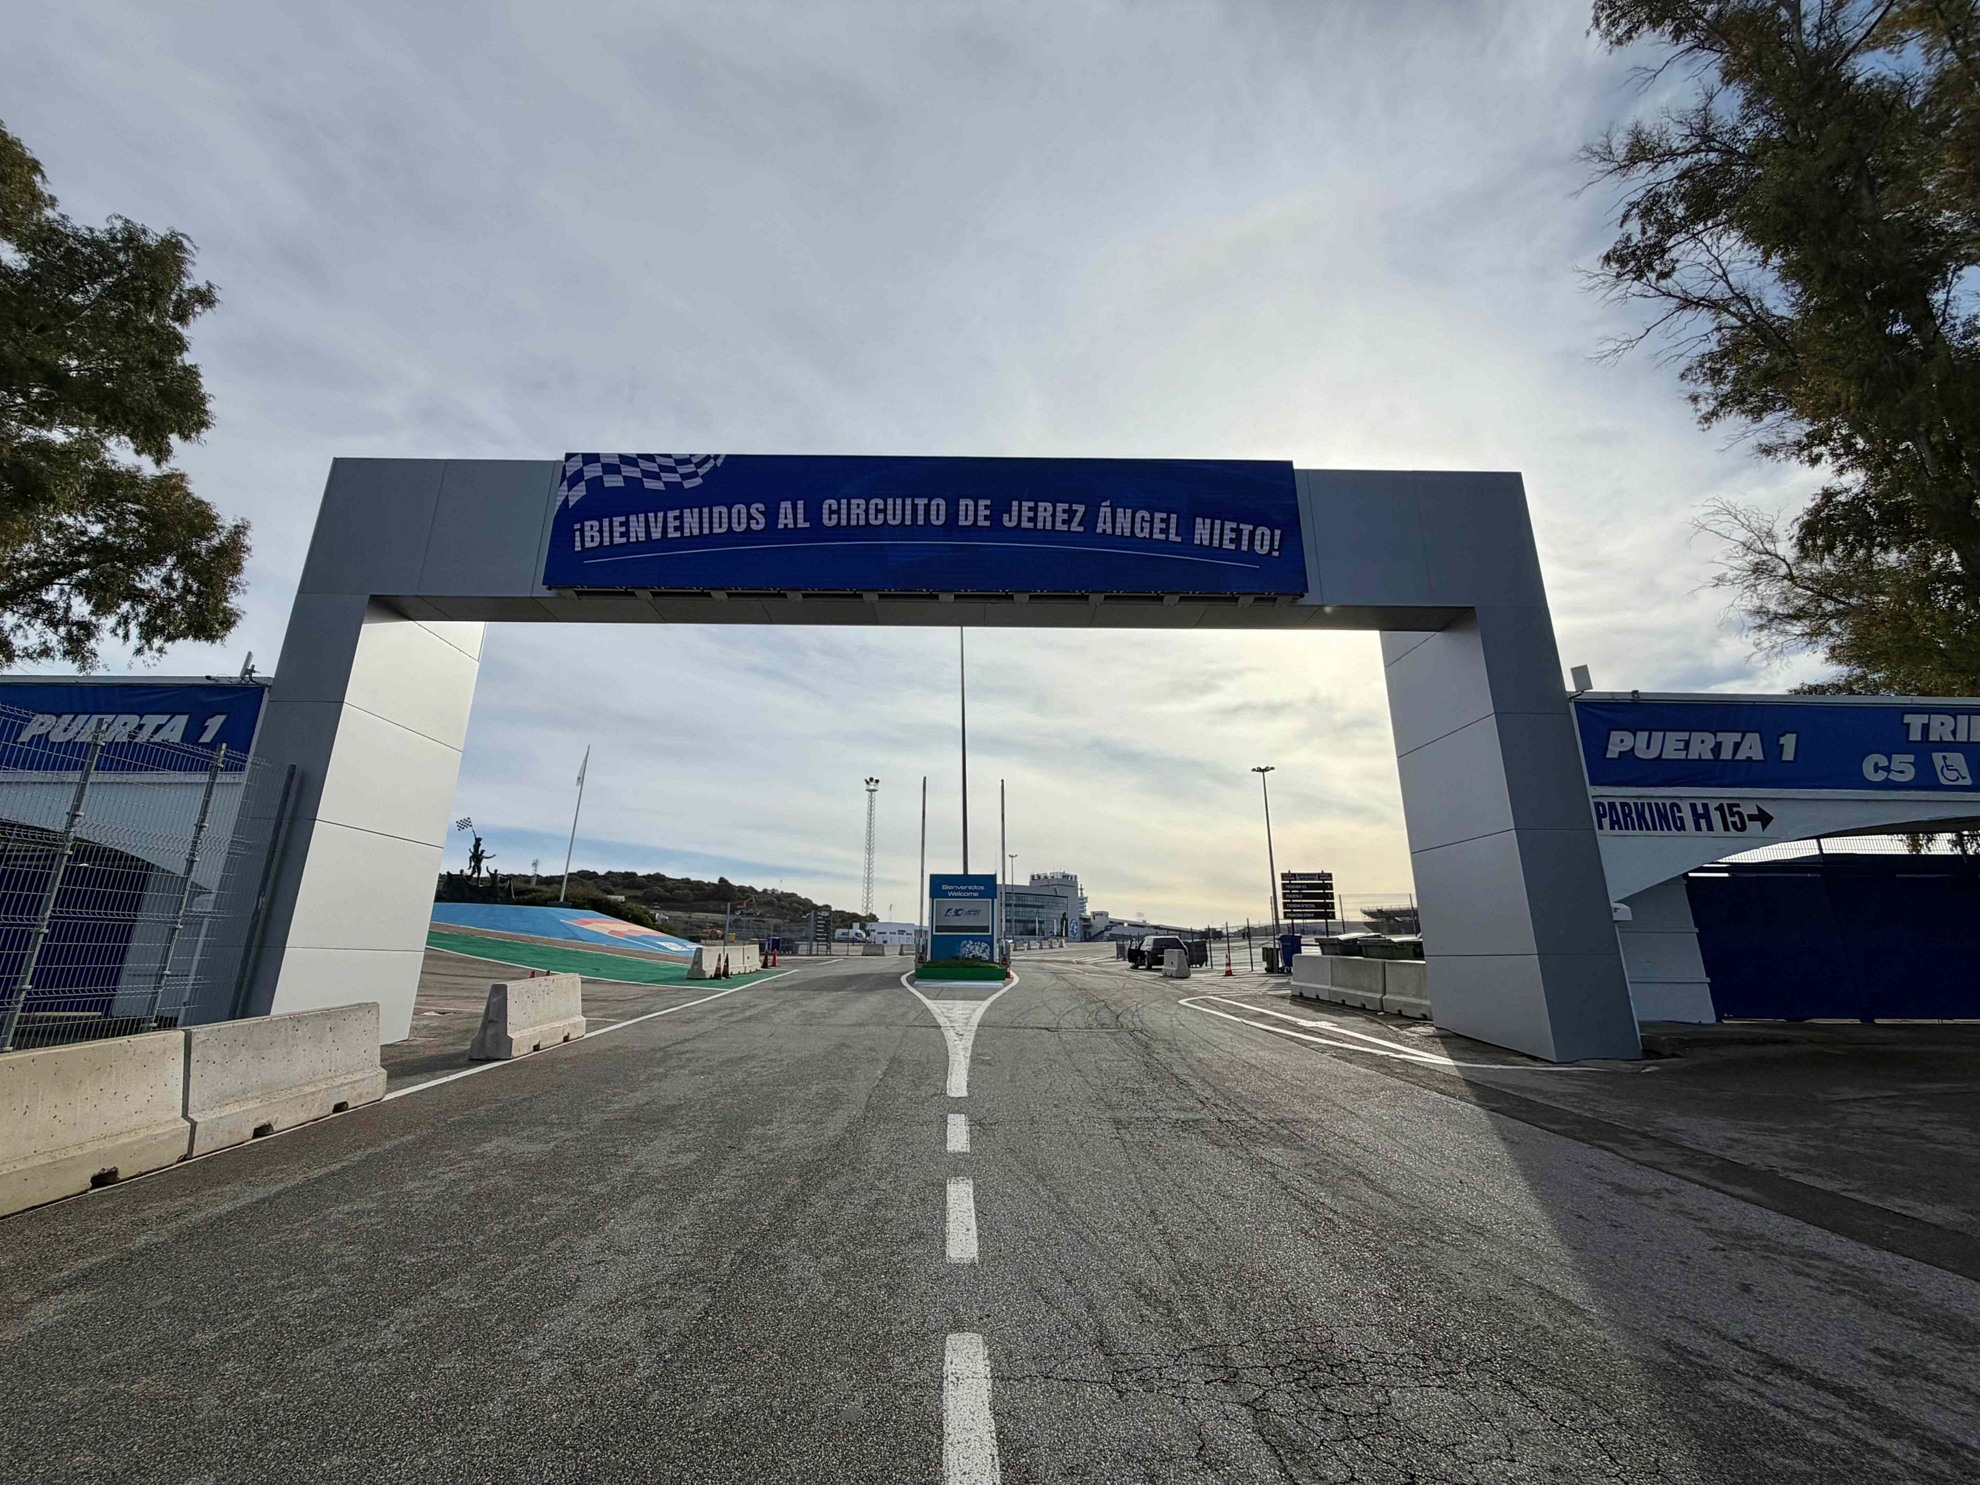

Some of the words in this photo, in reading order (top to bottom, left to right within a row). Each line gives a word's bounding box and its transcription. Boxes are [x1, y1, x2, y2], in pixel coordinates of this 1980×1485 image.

[573, 502, 766, 552] ¡BIENVENIDOS
[778, 499, 811, 530] AL
[821, 497, 946, 528] CIRCUITO
[958, 497, 991, 528] DE
[1002, 498, 1085, 533] JEREZ
[1096, 499, 1182, 542] ÁNGEL
[1193, 516, 1282, 557] NIETO!
[17, 713, 190, 743] PUERTA
[198, 714, 228, 744] 1
[1604, 731, 1765, 761] PUERTA
[1778, 733, 1798, 762] 1
[1861, 753, 1916, 783] C5
[1594, 801, 1687, 833] PARKING
